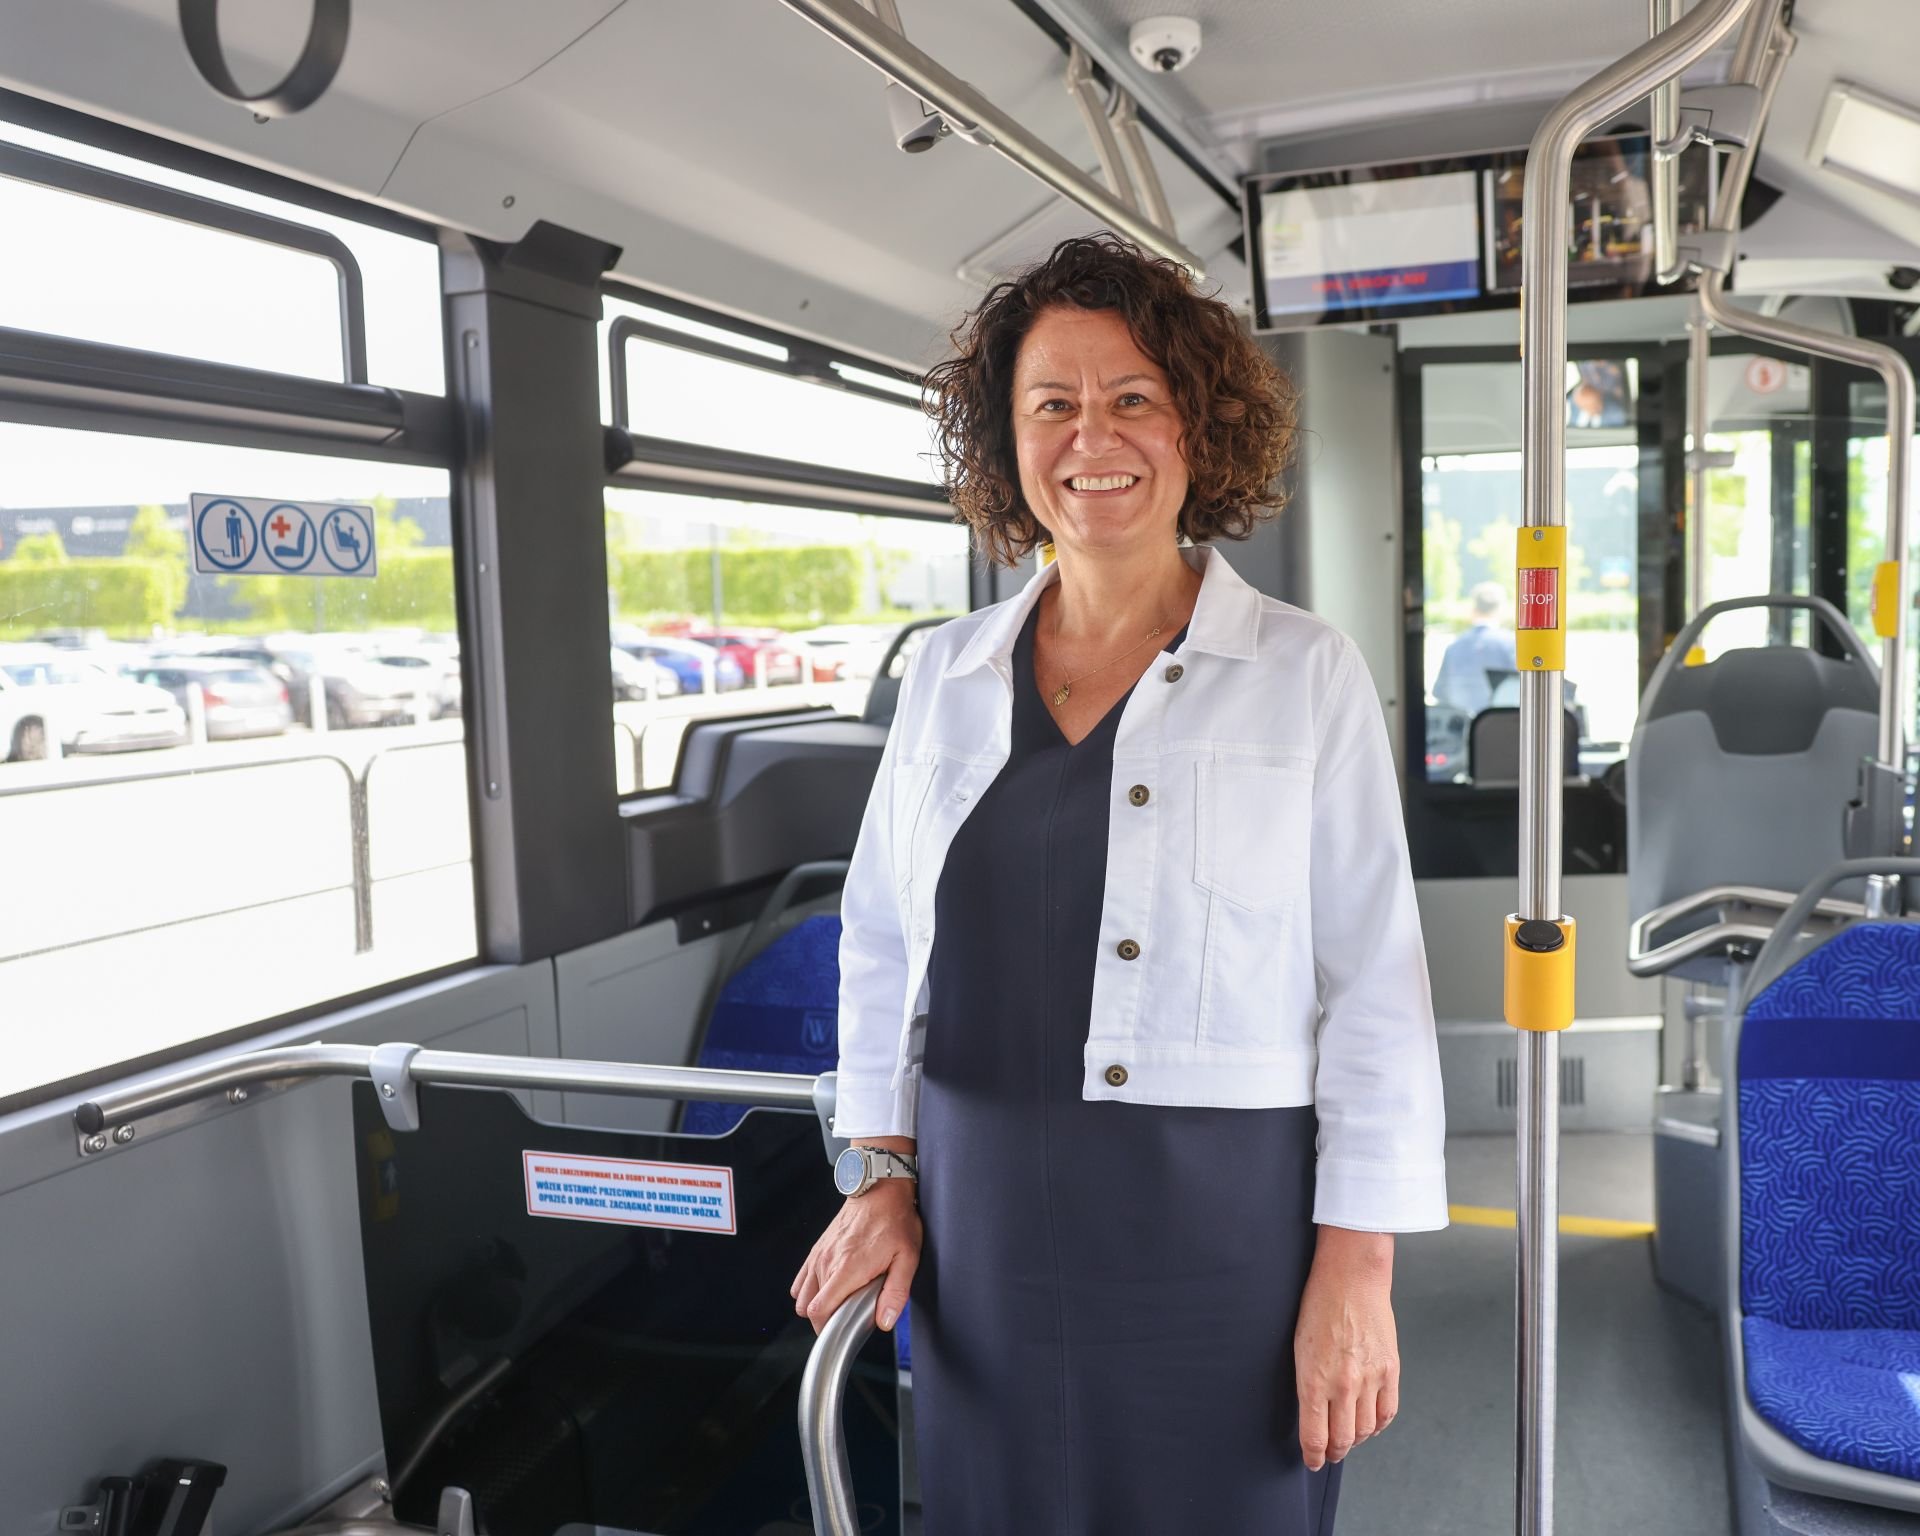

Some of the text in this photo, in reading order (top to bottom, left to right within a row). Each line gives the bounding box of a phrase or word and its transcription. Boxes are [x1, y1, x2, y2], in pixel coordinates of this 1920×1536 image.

[1522, 593, 1554, 605] STOP
[536, 1181, 562, 1190] WÓZEK
[563, 1183, 597, 1194] USTAWIĆ
[599, 1186, 645, 1197] PRZECIWNIE
[646, 1191, 657, 1199] DO
[658, 1192, 698, 1202] KIERUNKU
[538, 1193, 567, 1203] OPRZEĆ
[609, 1199, 653, 1212] ZACIĄGNĄĆ
[654, 1204, 691, 1215] HAMULEC
